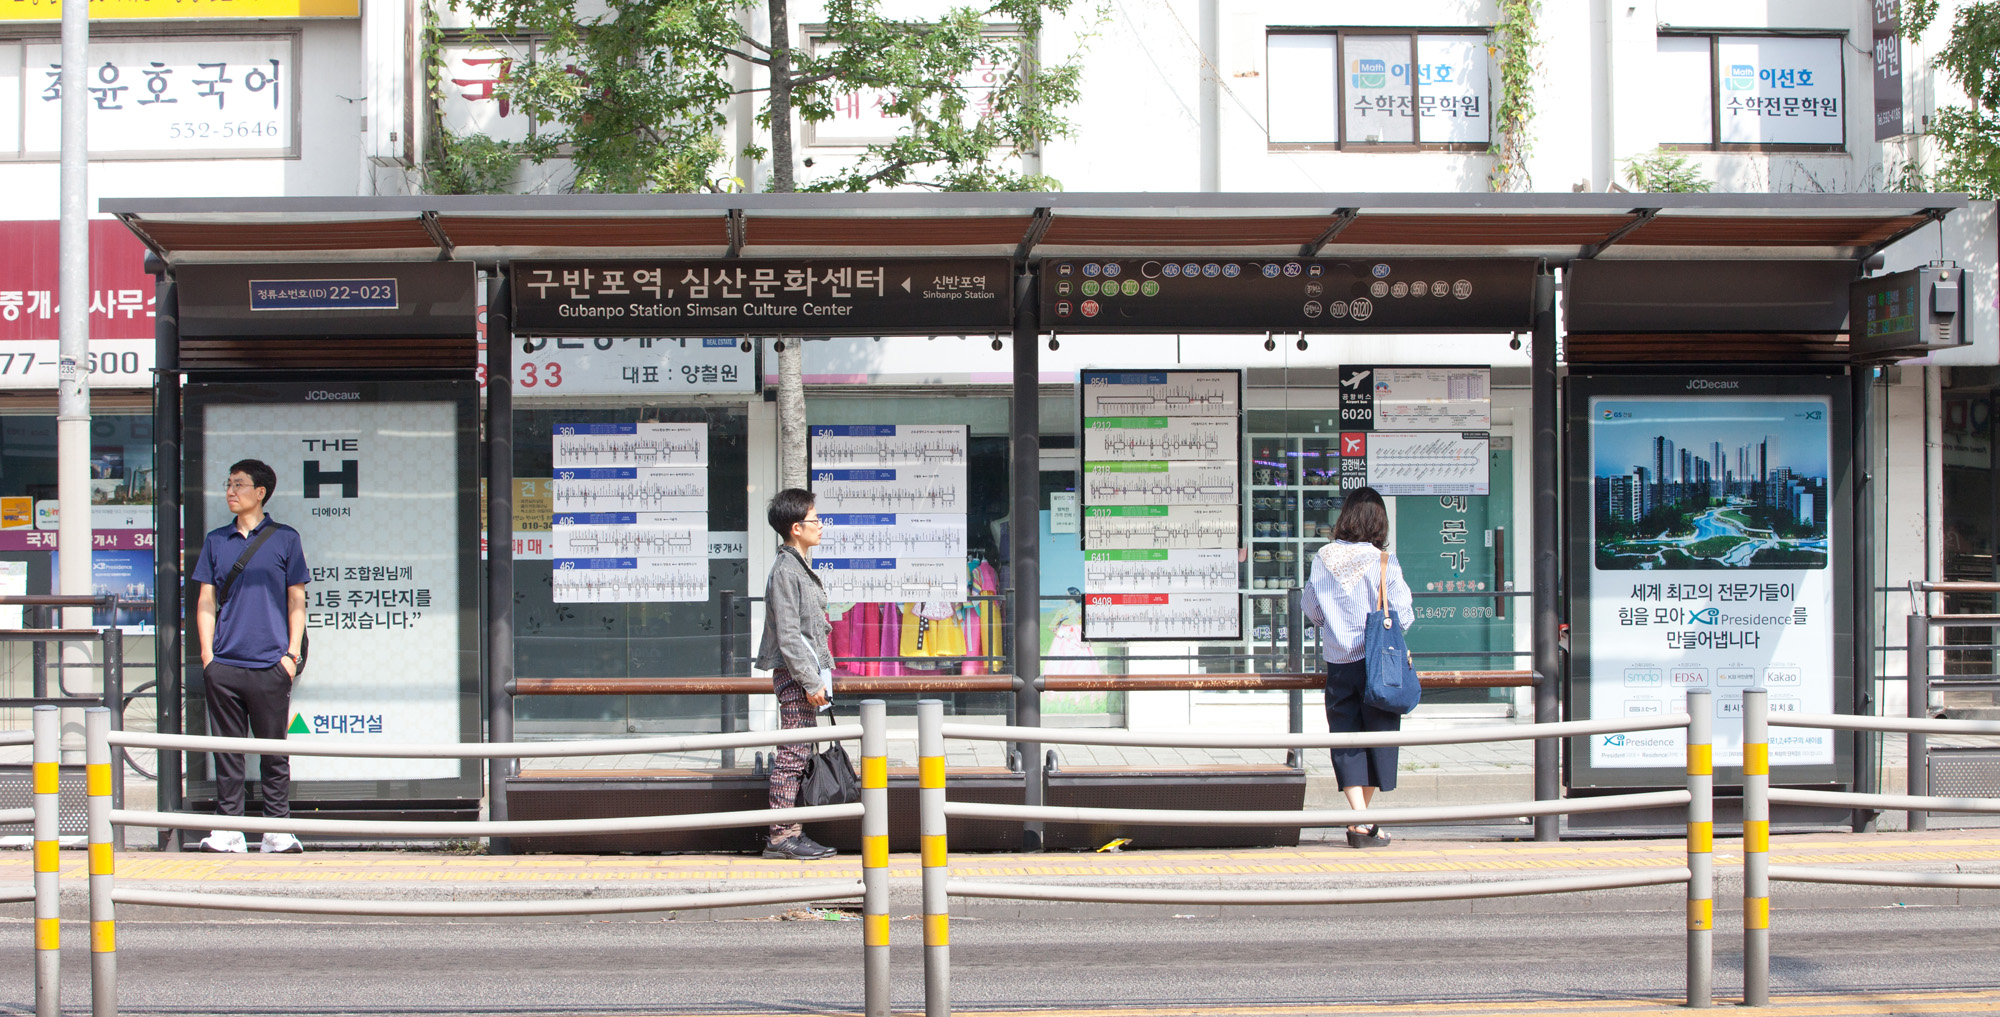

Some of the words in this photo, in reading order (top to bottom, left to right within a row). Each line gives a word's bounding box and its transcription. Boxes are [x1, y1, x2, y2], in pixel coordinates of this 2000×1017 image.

[1876, 33, 1900, 79] 학원
[1361, 63, 1384, 72] Math
[1732, 68, 1753, 76] Math
[1391, 63, 1453, 86] 이선호
[1759, 68, 1814, 89] 이선호
[192, 59, 281, 110] 국어
[1353, 95, 1480, 117] 수학전문학원
[1726, 97, 1837, 117] 수학전문학원
[170, 120, 278, 139] 532-5646
[1086, 265, 1099, 275] 148
[1106, 265, 1118, 275] 360
[1164, 265, 1178, 275] 406
[1185, 265, 1198, 275] 462
[1205, 265, 1217, 275] 540
[1225, 265, 1238, 275] 640
[1265, 265, 1278, 275] 643
[1286, 264, 1299, 275] 362
[932, 275, 986, 290] 신반포역
[1124, 281, 1137, 293] 3012
[1144, 282, 1157, 294] 6411
[257, 287, 327, 301] 정류소번호(ID)
[329, 285, 392, 301] 22-023
[923, 290, 962, 300] Sinbanpo
[965, 289, 995, 299] Station
[558, 304, 625, 319] Gubanpo
[629, 303, 681, 317] Station
[686, 303, 738, 317] Simsan
[743, 302, 798, 316] Culture
[802, 302, 853, 316] Center
[1333, 303, 1346, 315] 6000
[1353, 301, 1369, 317] 6020
[61, 365, 75, 374] 235
[622, 366, 659, 383] 대표
[681, 365, 738, 383] 양철원
[1090, 377, 1109, 388] 8541
[1685, 379, 1739, 390] JCDecaux
[305, 390, 361, 401] JCDecaux
[1341, 408, 1372, 420] 6020
[559, 426, 575, 437] 360
[1091, 420, 1112, 431] 4212
[818, 428, 834, 440] 540
[302, 439, 359, 451] THE
[1092, 465, 1111, 476] 4318
[1341, 458, 1366, 471] 공항버스
[303, 459, 359, 498] H
[559, 471, 575, 481] 362
[818, 472, 834, 483] 640
[1342, 477, 1366, 490] 6000
[311, 507, 351, 517] 디에이치
[1091, 508, 1112, 519] 3012
[558, 516, 575, 527] 406
[26, 533, 57, 548] 국제
[1091, 552, 1111, 563] 6411
[559, 560, 575, 571] 462
[818, 561, 834, 572] 643
[344, 566, 413, 581] 조합원님께
[315, 589, 342, 608] 1등
[347, 589, 432, 608] 주거단지를
[1630, 583, 1662, 602] 세계
[1666, 583, 1713, 602] 최고의
[1717, 583, 1795, 602] 전문가들이
[1091, 597, 1112, 607] 9408
[1415, 607, 1456, 619] T.3477
[1462, 607, 1493, 618] 8870
[1618, 607, 1649, 626] 힘을
[1653, 607, 1685, 625] 모아
[1666, 631, 1760, 649] 만들어냅니다
[1675, 672, 1703, 683] EDSA
[1767, 672, 1797, 682] Kakao
[1723, 704, 1744, 712] 최시
[1769, 703, 1795, 712] 김치호
[313, 714, 383, 734] 현대건설
[1625, 738, 1675, 747] Presidence
